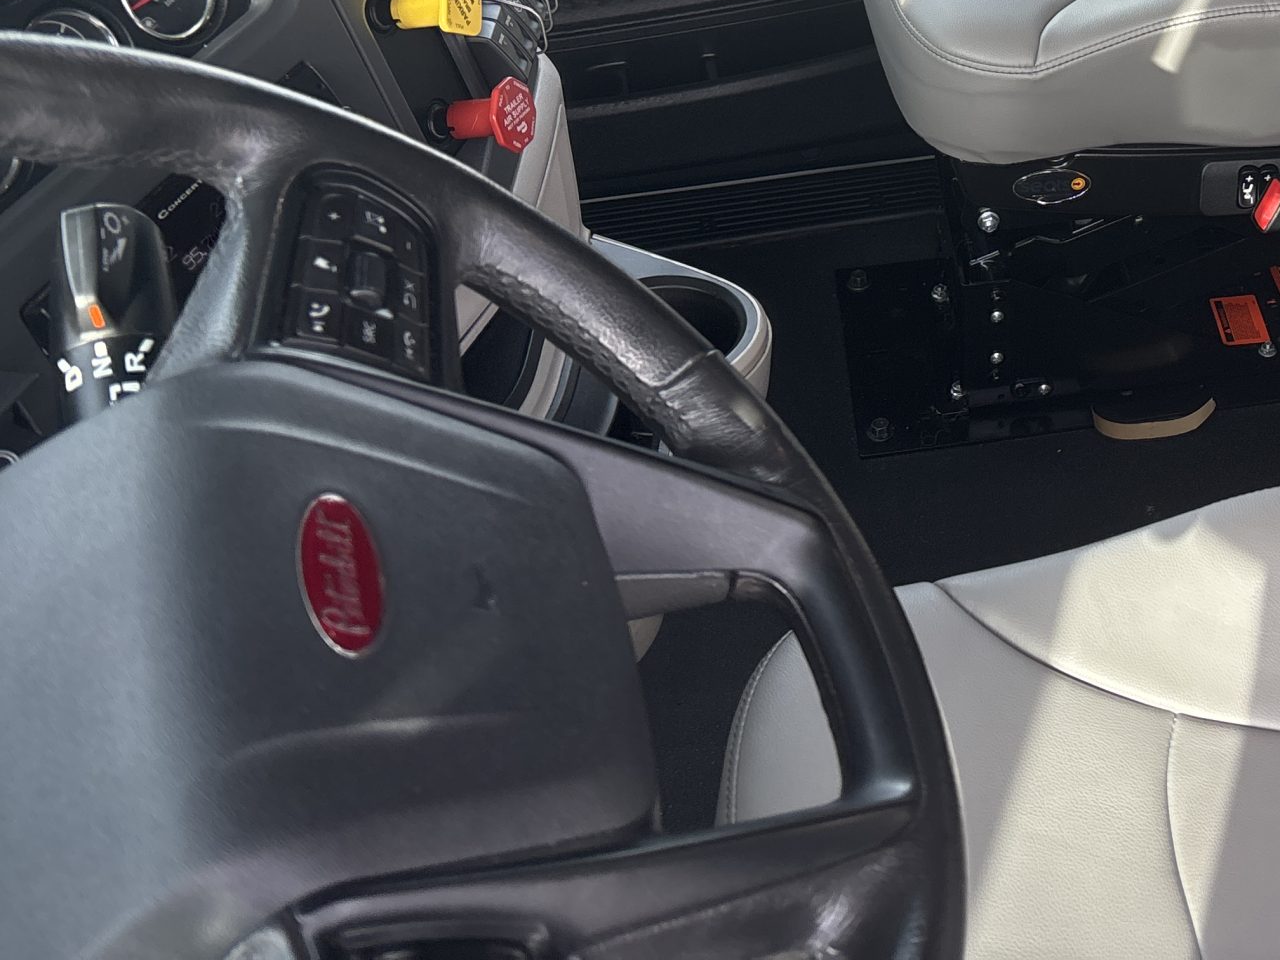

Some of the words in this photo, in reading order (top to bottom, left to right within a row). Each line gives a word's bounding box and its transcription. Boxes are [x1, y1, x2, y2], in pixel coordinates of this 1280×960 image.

[503, 114, 513, 127] AIR
[512, 97, 530, 119] SUPPLY
[504, 92, 524, 114] TRAILER
[91, 356, 113, 378] N
[124, 352, 146, 372] R
[65, 365, 83, 392] D
